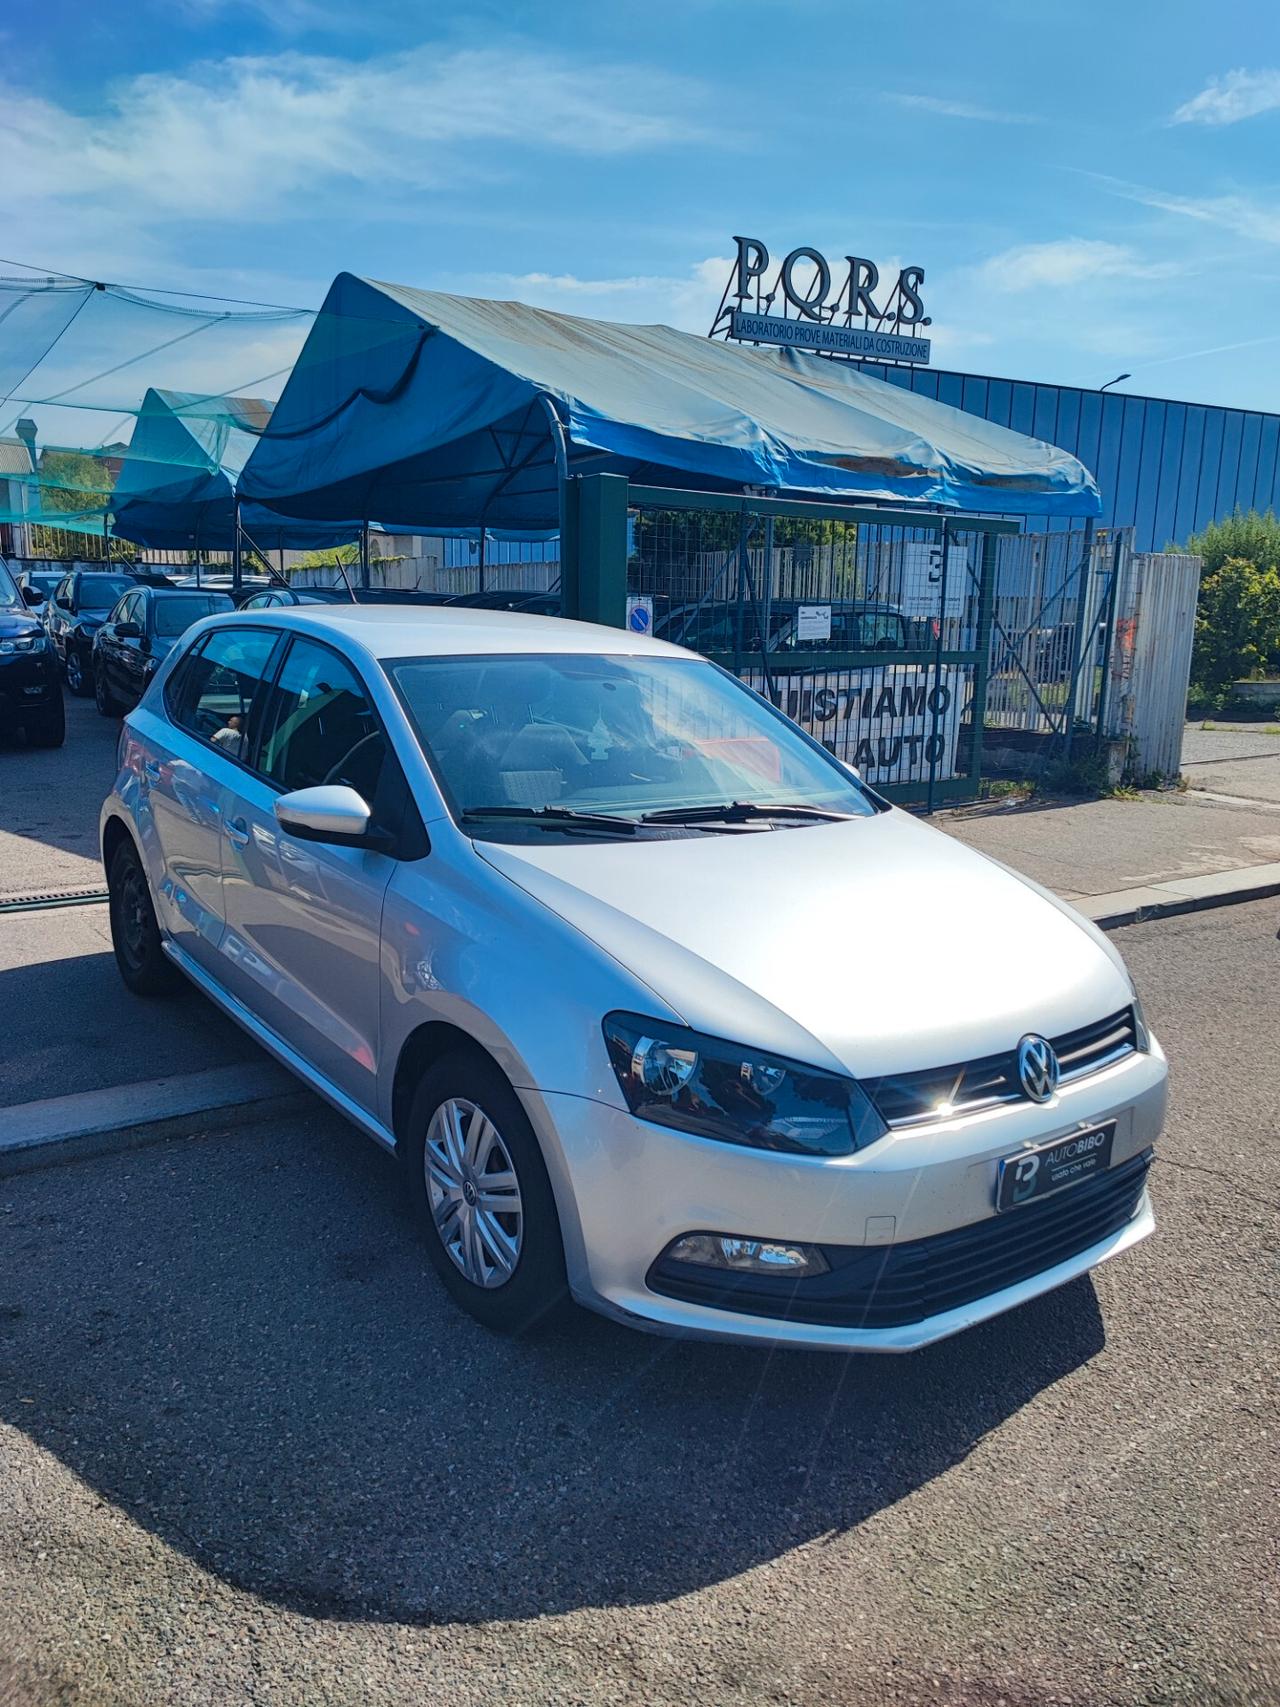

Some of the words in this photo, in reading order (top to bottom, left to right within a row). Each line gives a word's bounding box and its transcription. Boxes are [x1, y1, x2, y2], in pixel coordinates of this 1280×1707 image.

[732, 236, 932, 326] P.Q.R.S.
[736, 318, 793, 340] LABORATORIO
[794, 327, 821, 345] PROVE
[821, 331, 862, 350] MATERIALI
[863, 337, 875, 351] DA
[875, 338, 928, 359] COSTRUZIONE
[757, 685, 951, 722] UISTIAMO
[852, 734, 945, 769] AUTO
[1045, 1132, 1105, 1167] AUTOBIBO
